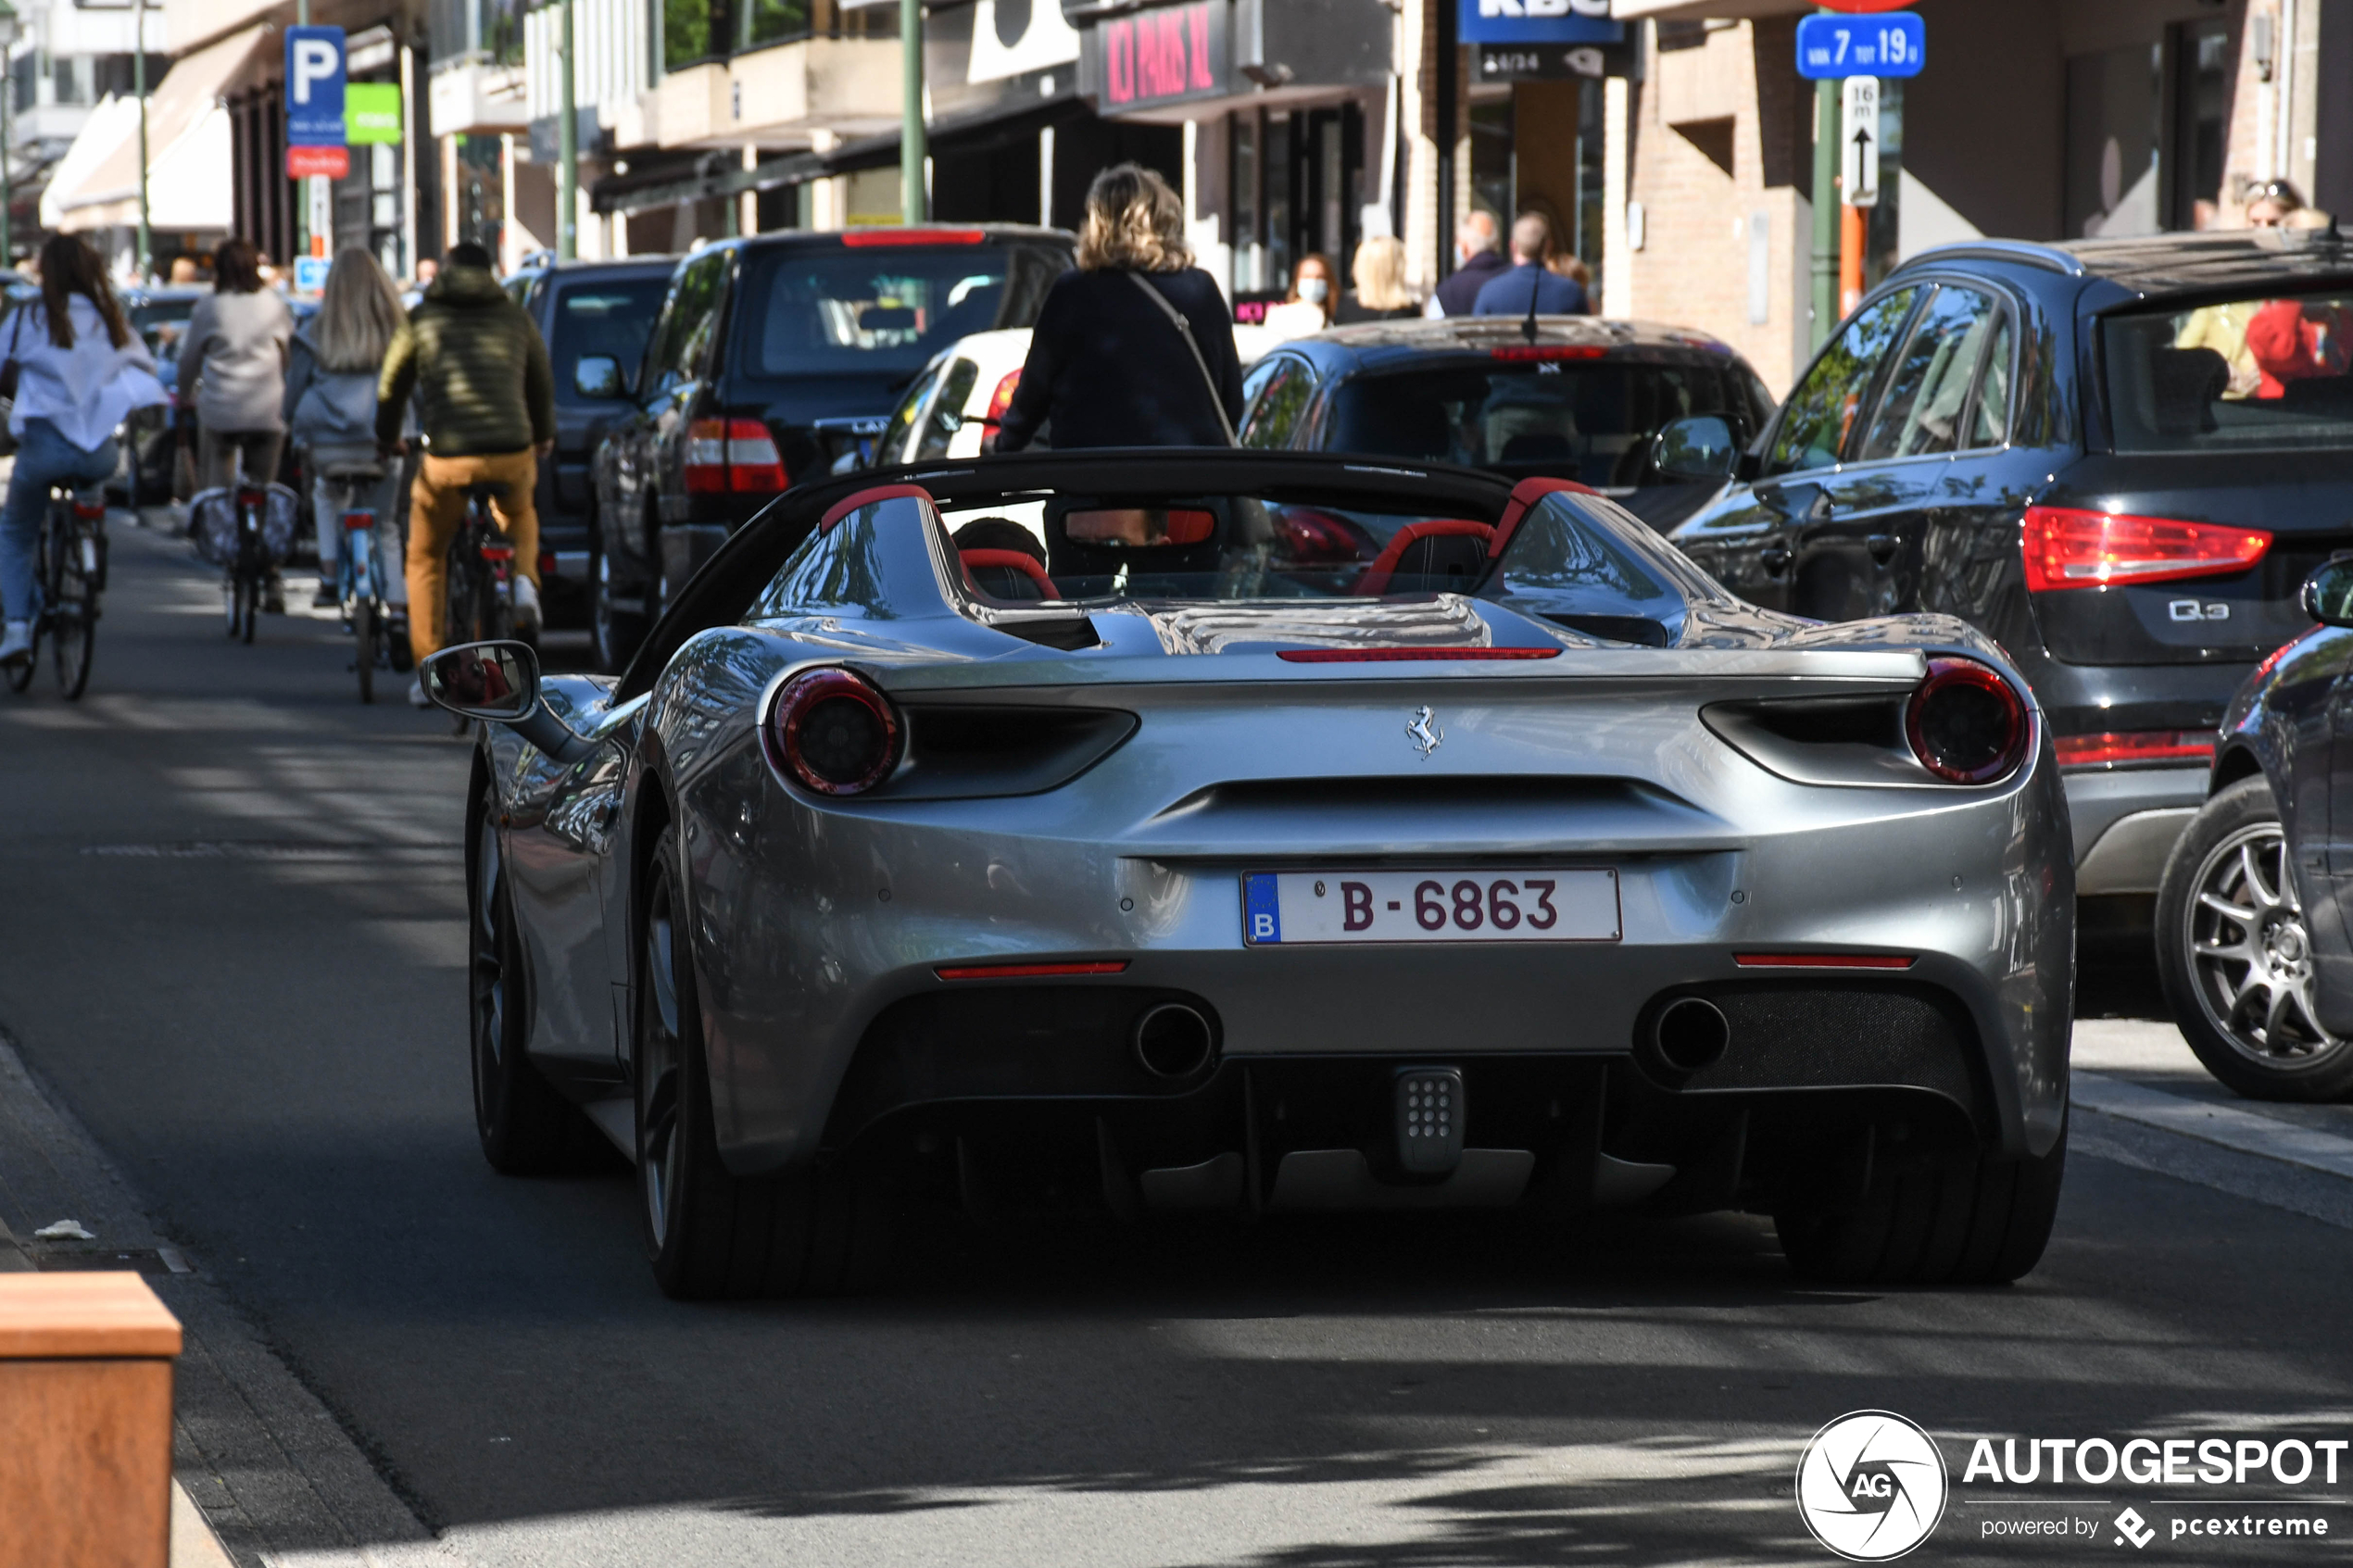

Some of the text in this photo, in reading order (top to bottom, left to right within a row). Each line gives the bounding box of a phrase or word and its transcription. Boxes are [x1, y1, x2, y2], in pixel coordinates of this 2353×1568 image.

[1834, 29, 1851, 65] 7
[1879, 27, 1906, 64] 19
[293, 39, 339, 105] P
[1854, 85, 1873, 102] 16
[2170, 599, 2230, 621] Q3
[1340, 879, 1558, 932] B-6863
[1254, 913, 1275, 937] B
